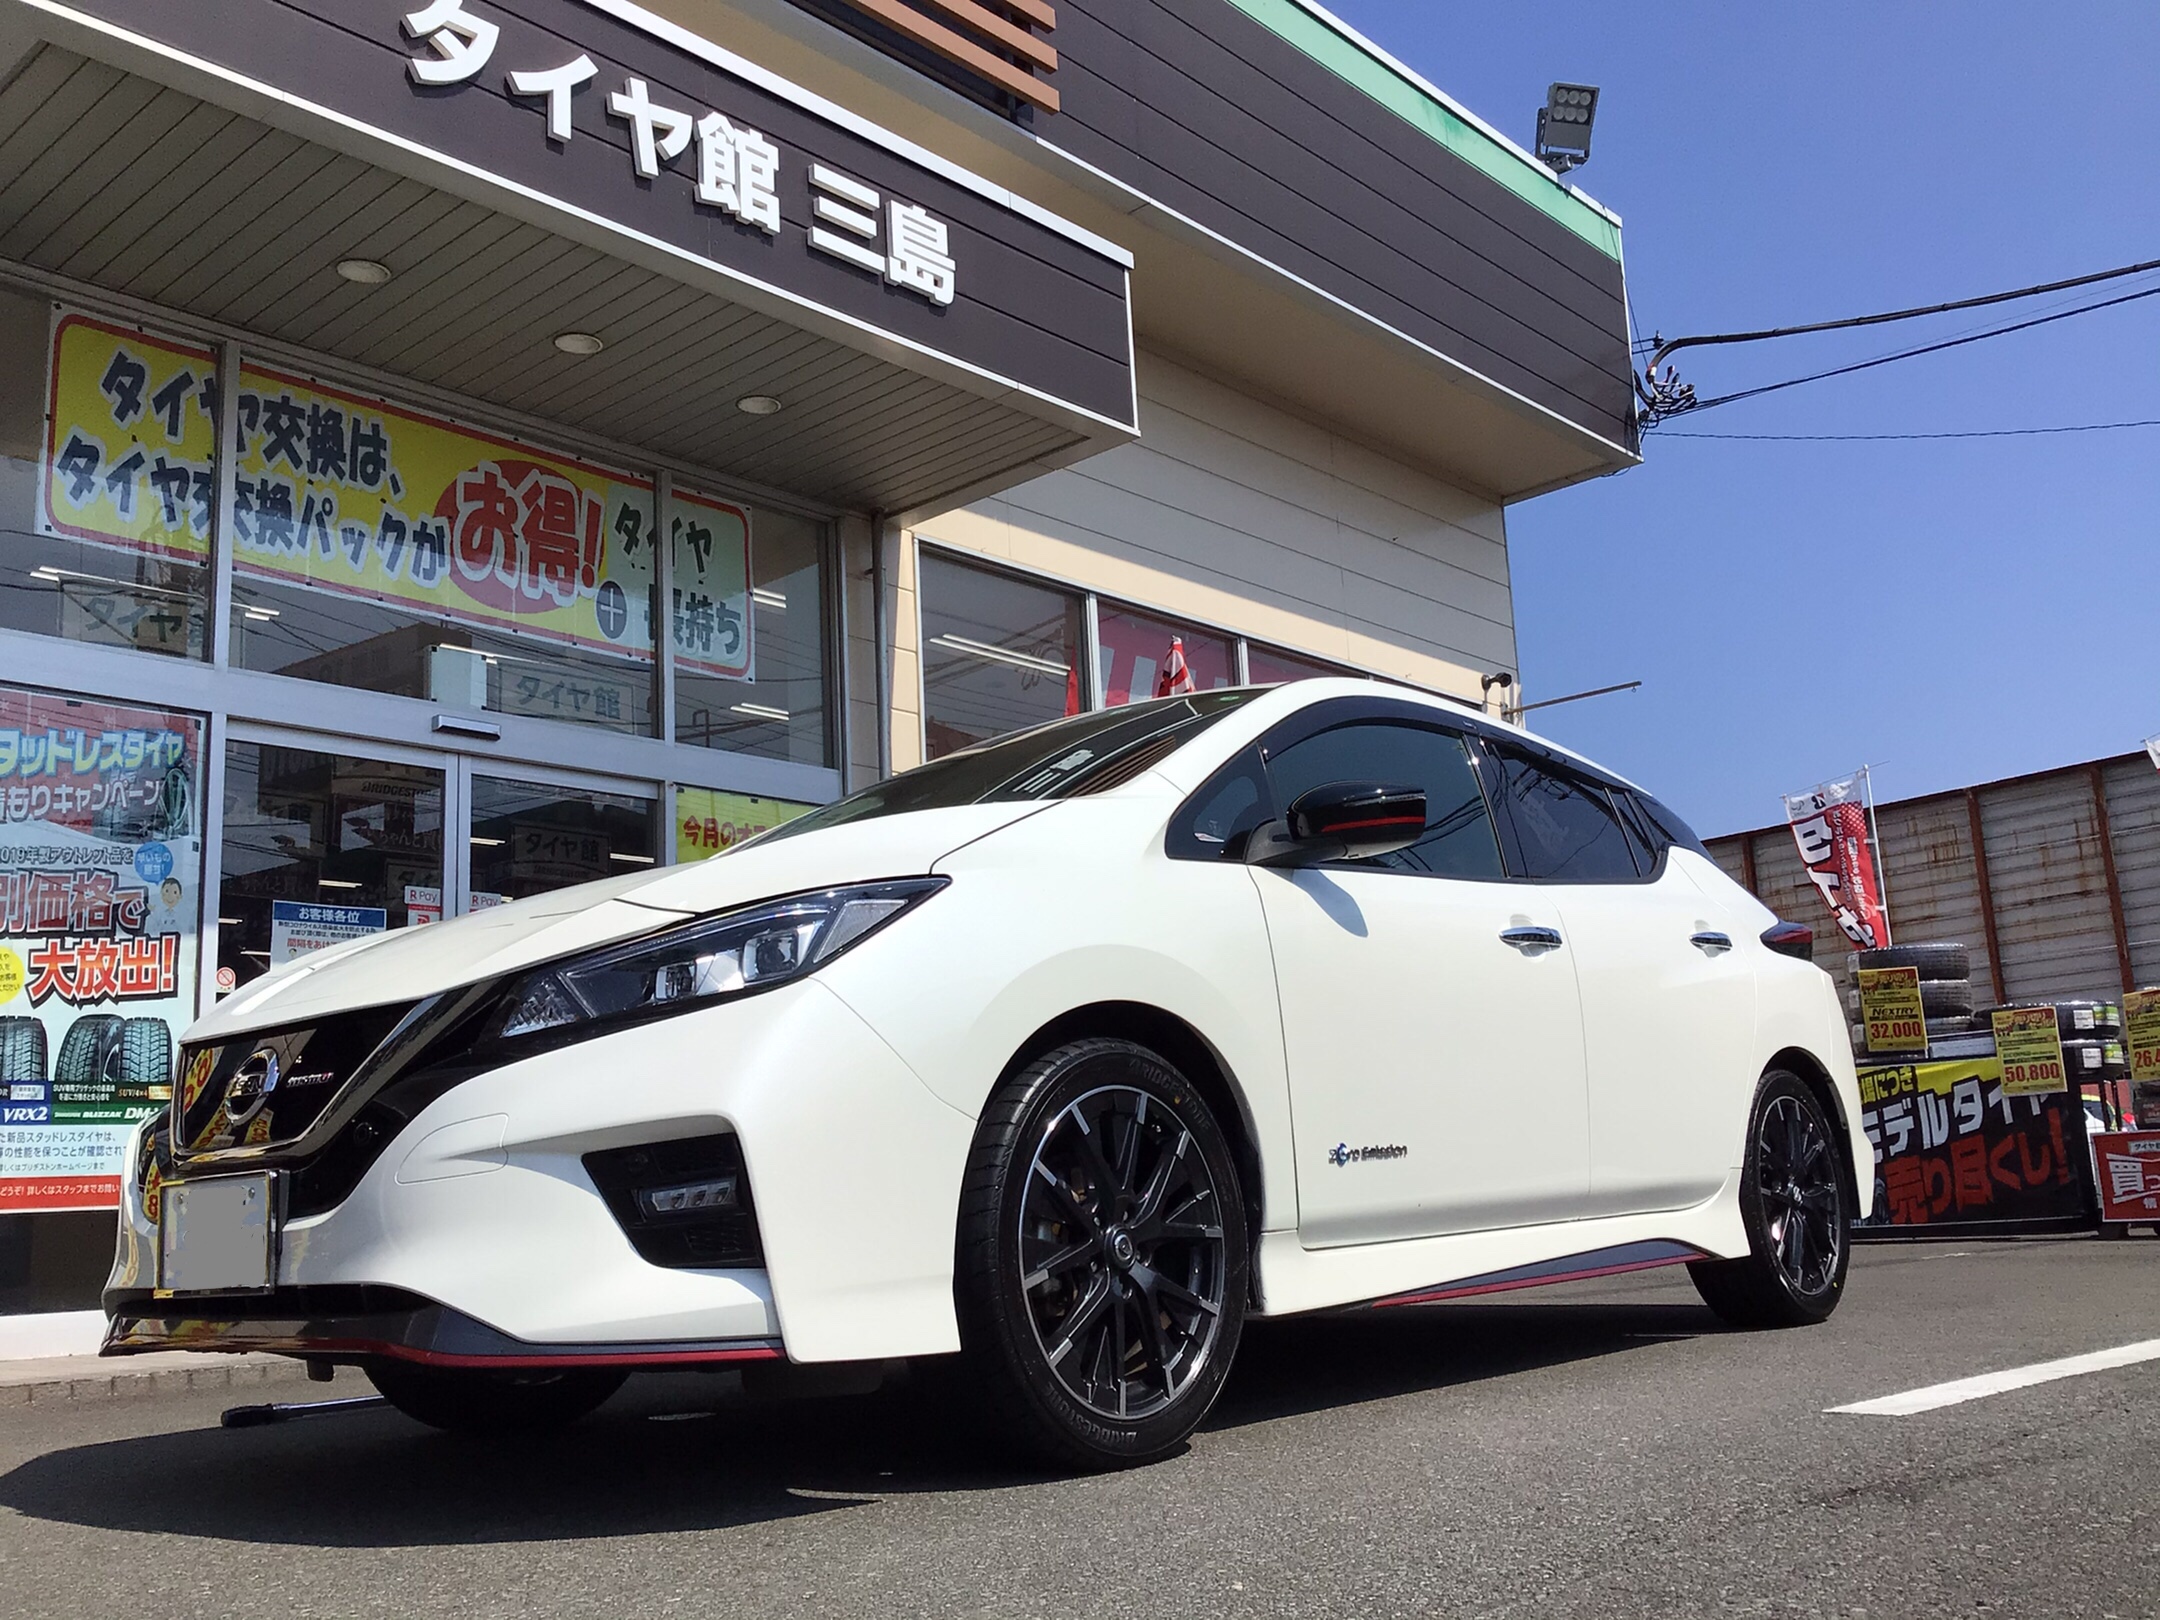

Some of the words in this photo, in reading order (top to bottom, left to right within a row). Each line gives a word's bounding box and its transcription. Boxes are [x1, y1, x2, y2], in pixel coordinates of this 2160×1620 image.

[402, 0, 781, 235] タイヤ館
[807, 162, 956, 307] 三島
[459, 468, 602, 600] お得!
[419, 890, 438, 903] Pay
[298, 907, 361, 924] お客様各位
[27, 935, 177, 1002] 大放出!
[1870, 1021, 1922, 1039] 32,000
[2004, 1062, 2060, 1083] 50,800
[3, 1106, 48, 1123] VRX2
